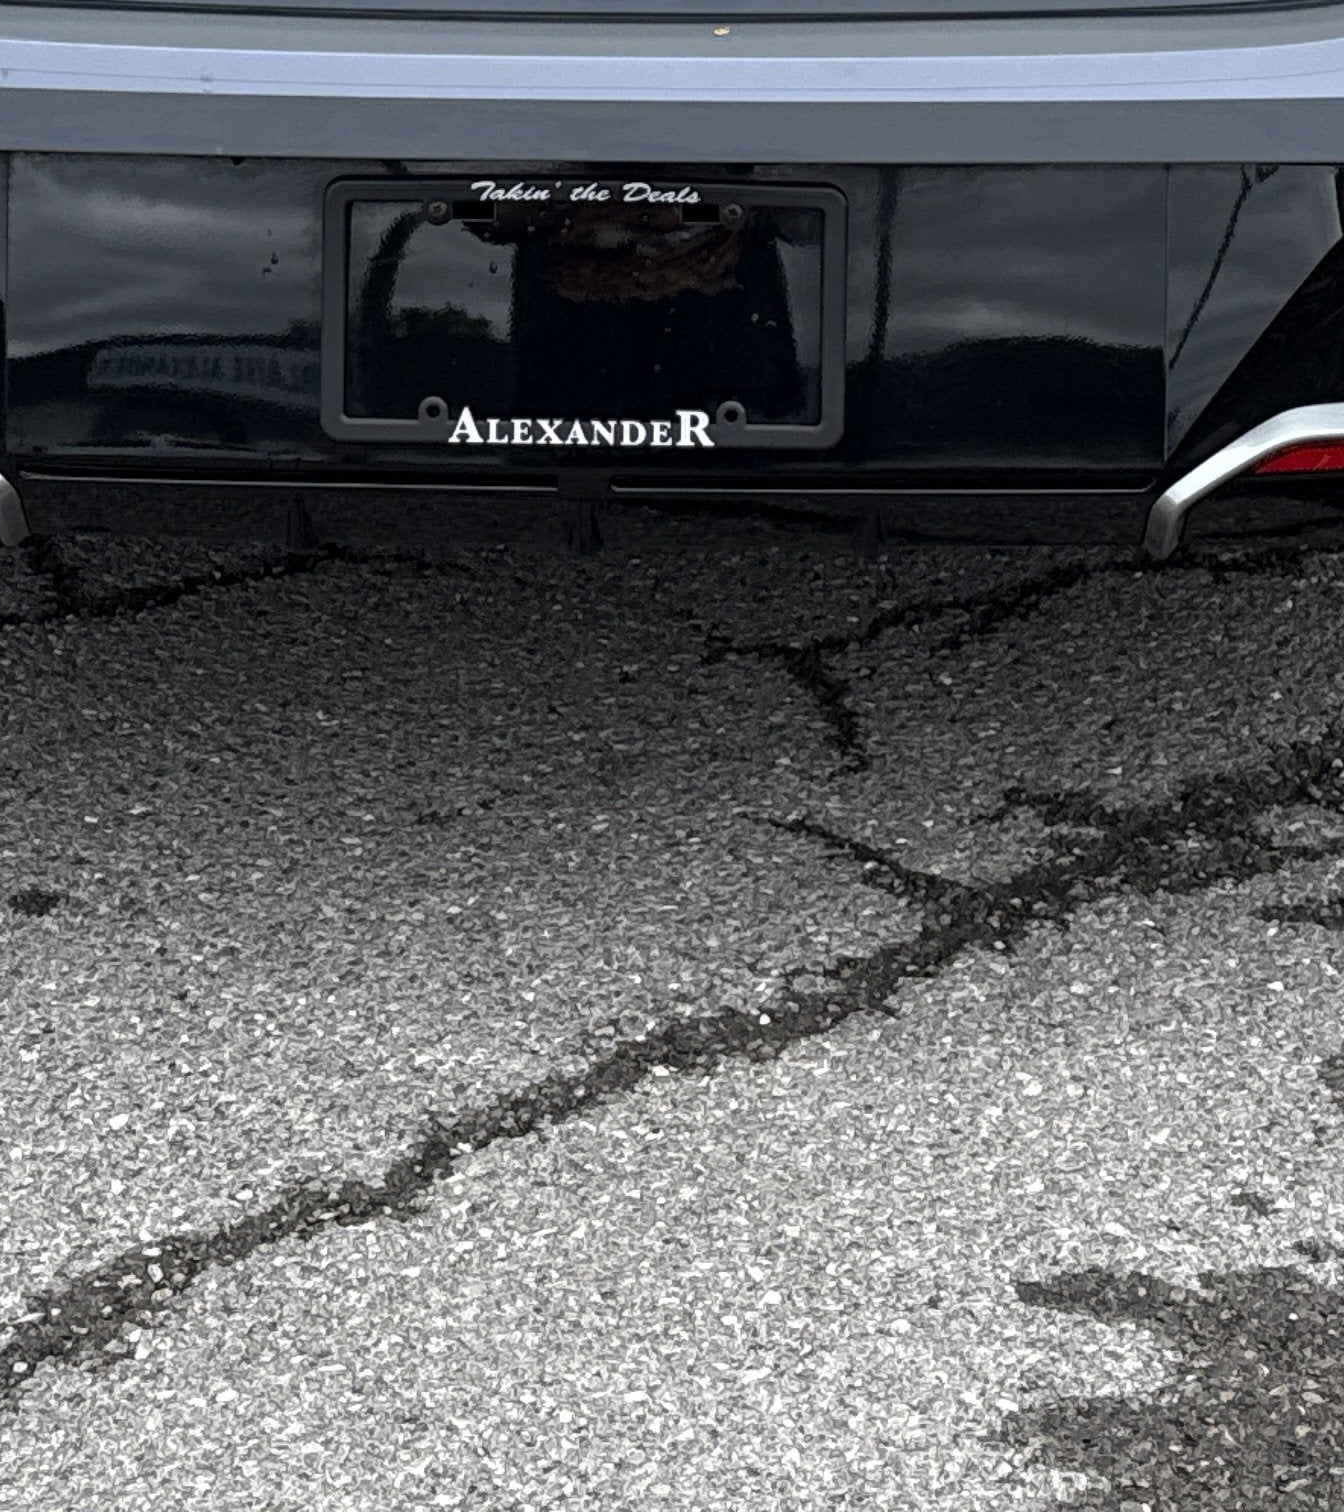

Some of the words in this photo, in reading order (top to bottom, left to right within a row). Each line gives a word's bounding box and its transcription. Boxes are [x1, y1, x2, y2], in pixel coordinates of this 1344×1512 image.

[470, 180, 562, 202] Takin'
[569, 182, 611, 202] the
[622, 182, 702, 204] Deals
[448, 406, 716, 448] ALEXANDER
